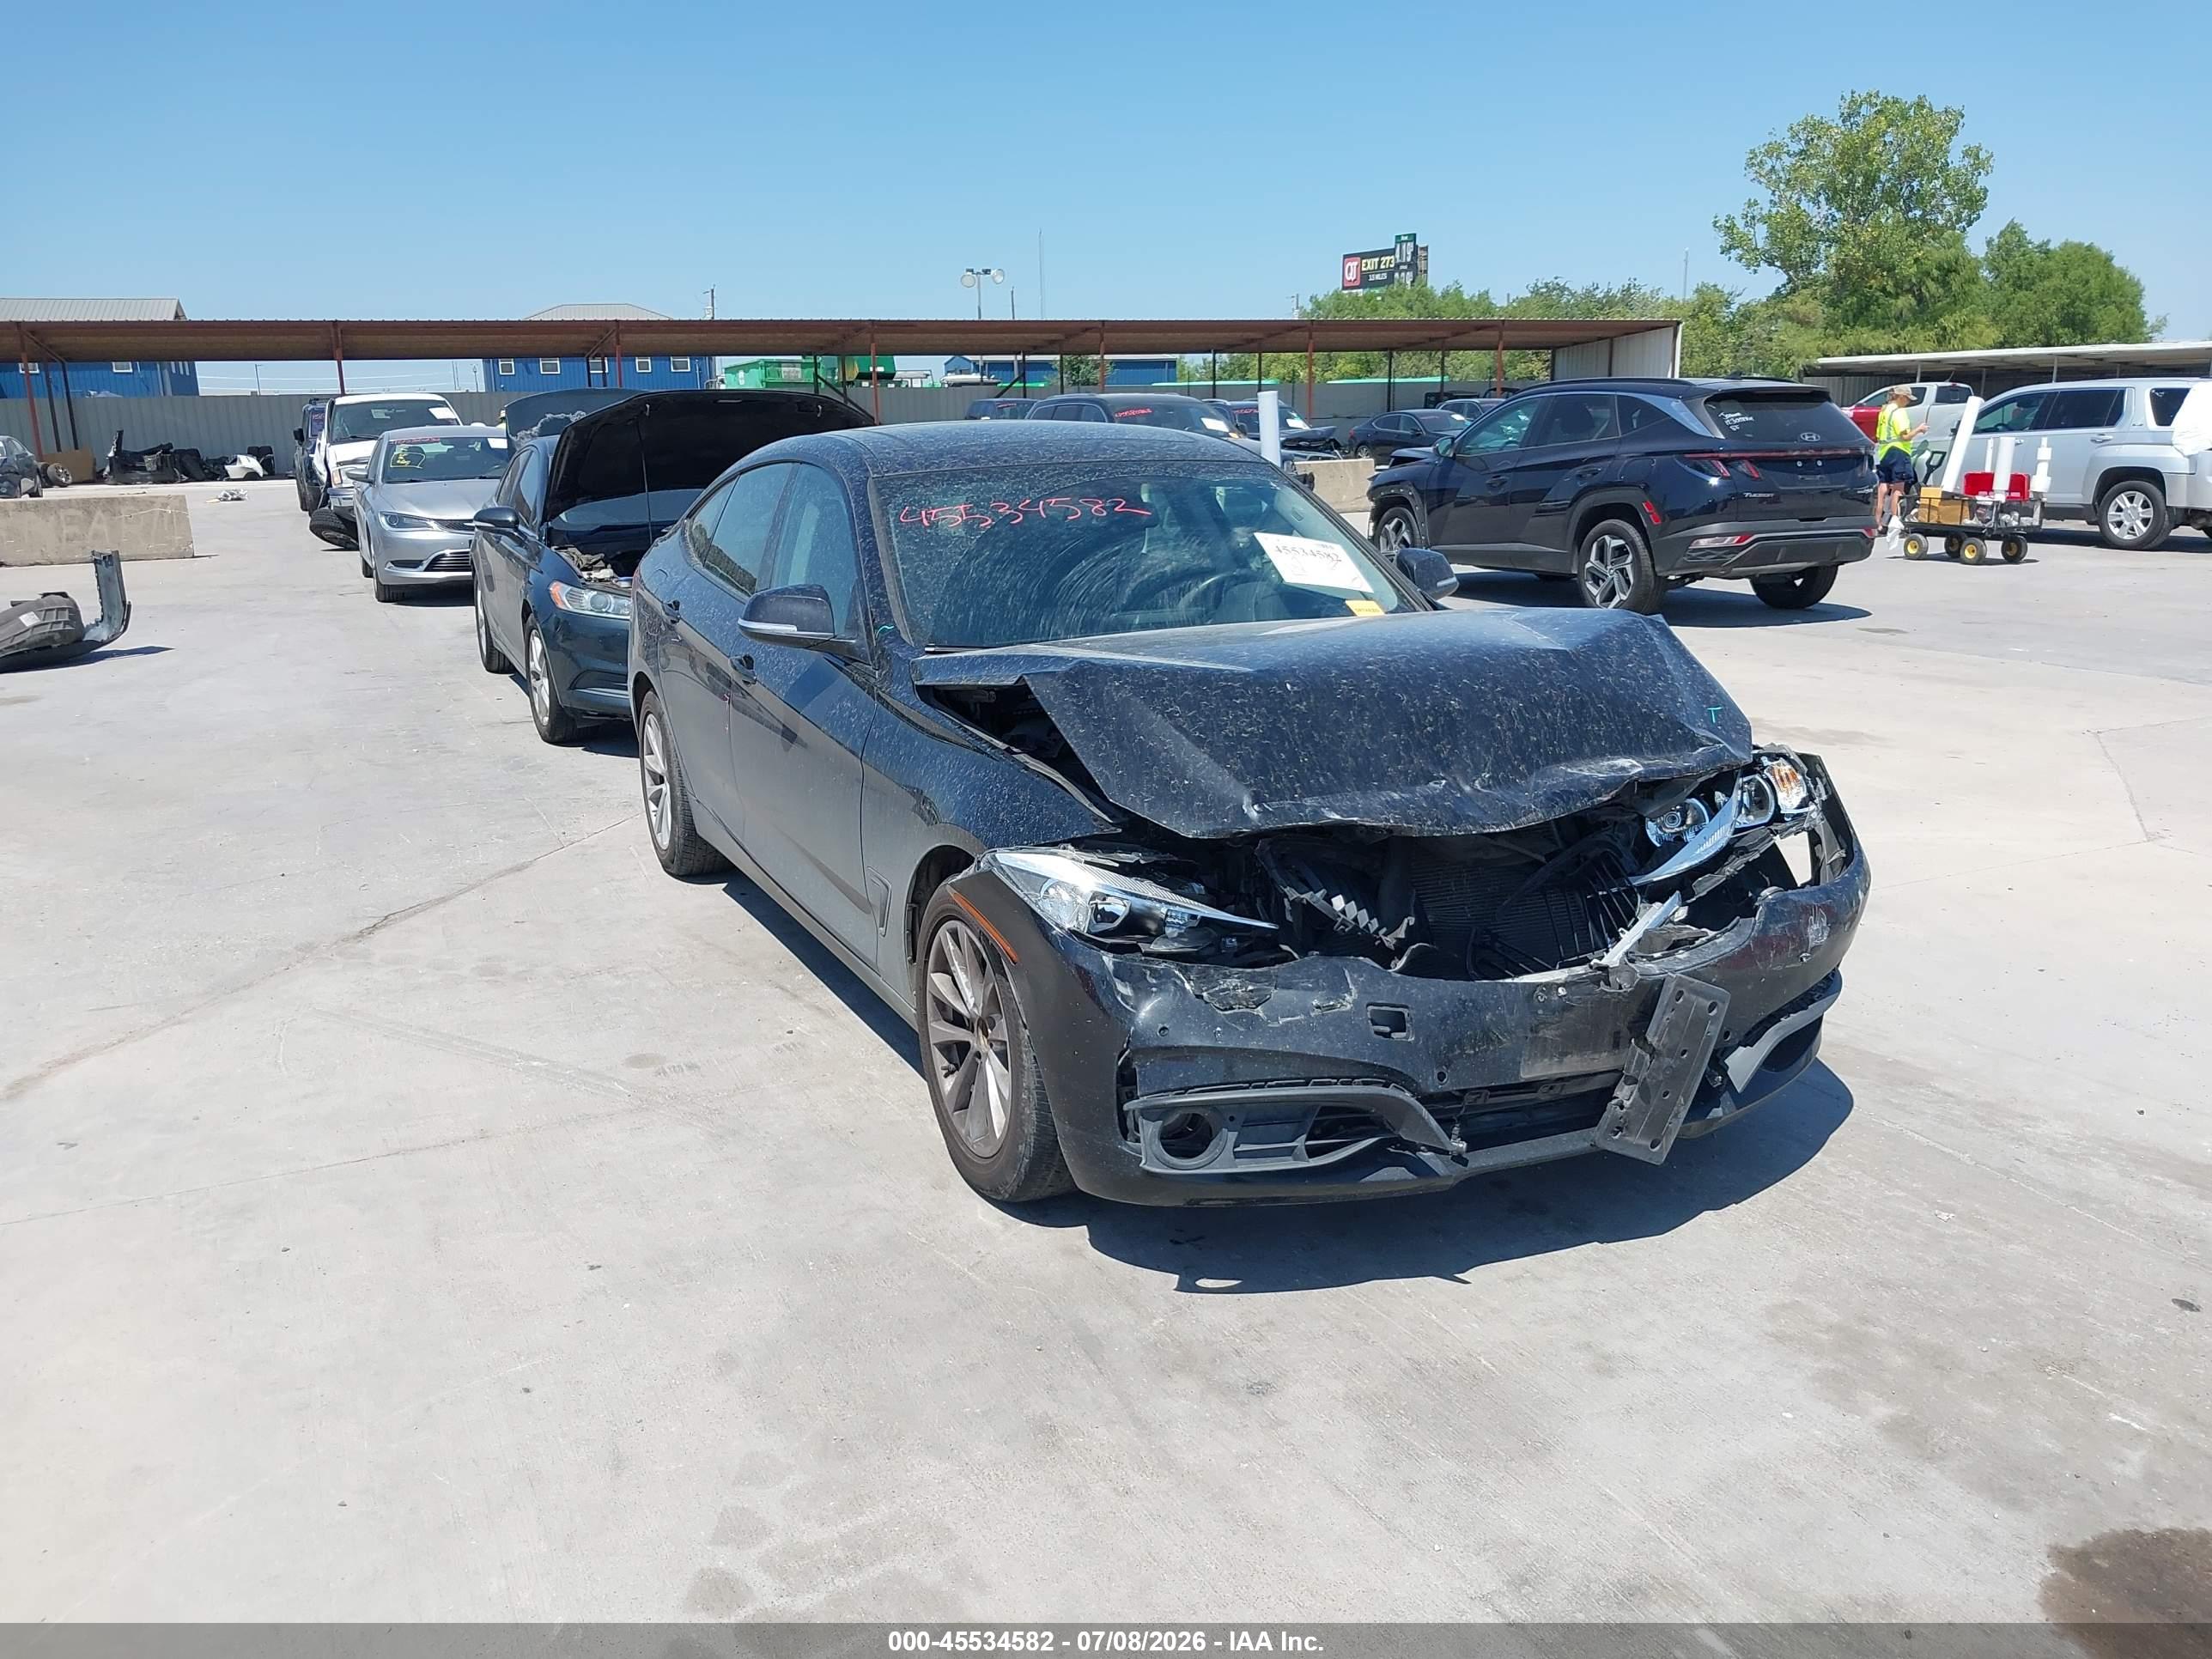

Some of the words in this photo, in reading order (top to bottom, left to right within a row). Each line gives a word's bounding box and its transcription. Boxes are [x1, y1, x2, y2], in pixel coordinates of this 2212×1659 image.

[1361, 258, 1379, 271] EXIT
[1380, 256, 1395, 269] 273
[899, 497, 1152, 528] 45534582
